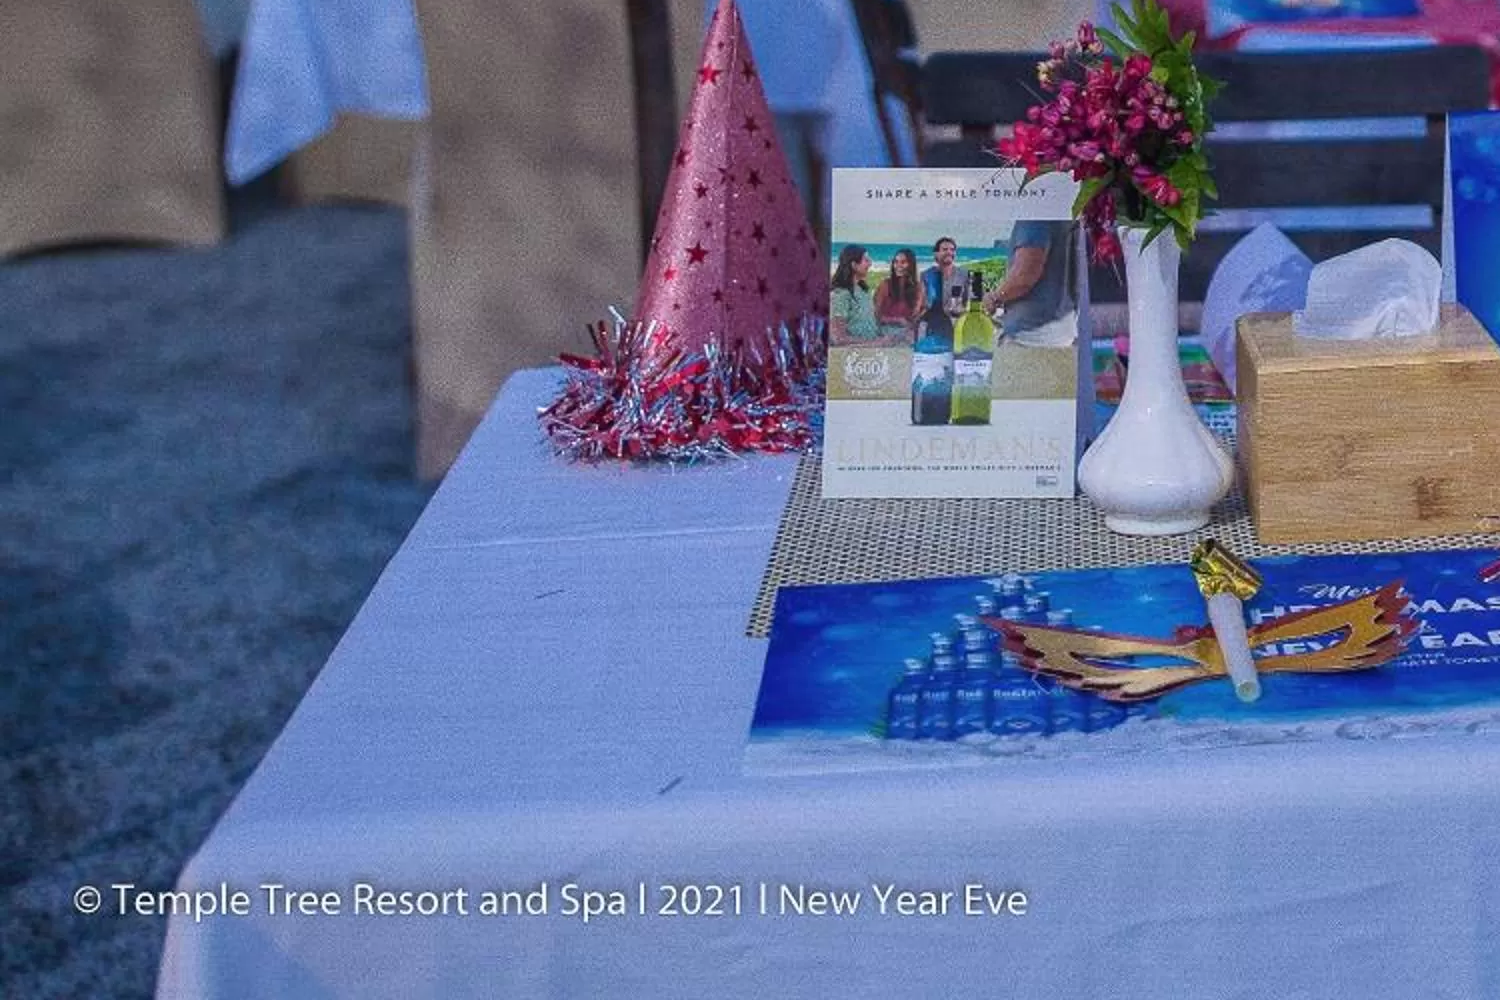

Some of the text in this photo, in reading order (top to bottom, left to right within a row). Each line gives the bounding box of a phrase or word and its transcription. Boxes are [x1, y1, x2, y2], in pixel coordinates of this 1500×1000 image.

[865, 188, 913, 199] SHARE
[919, 189, 928, 199] A
[935, 188, 978, 199] SMILE
